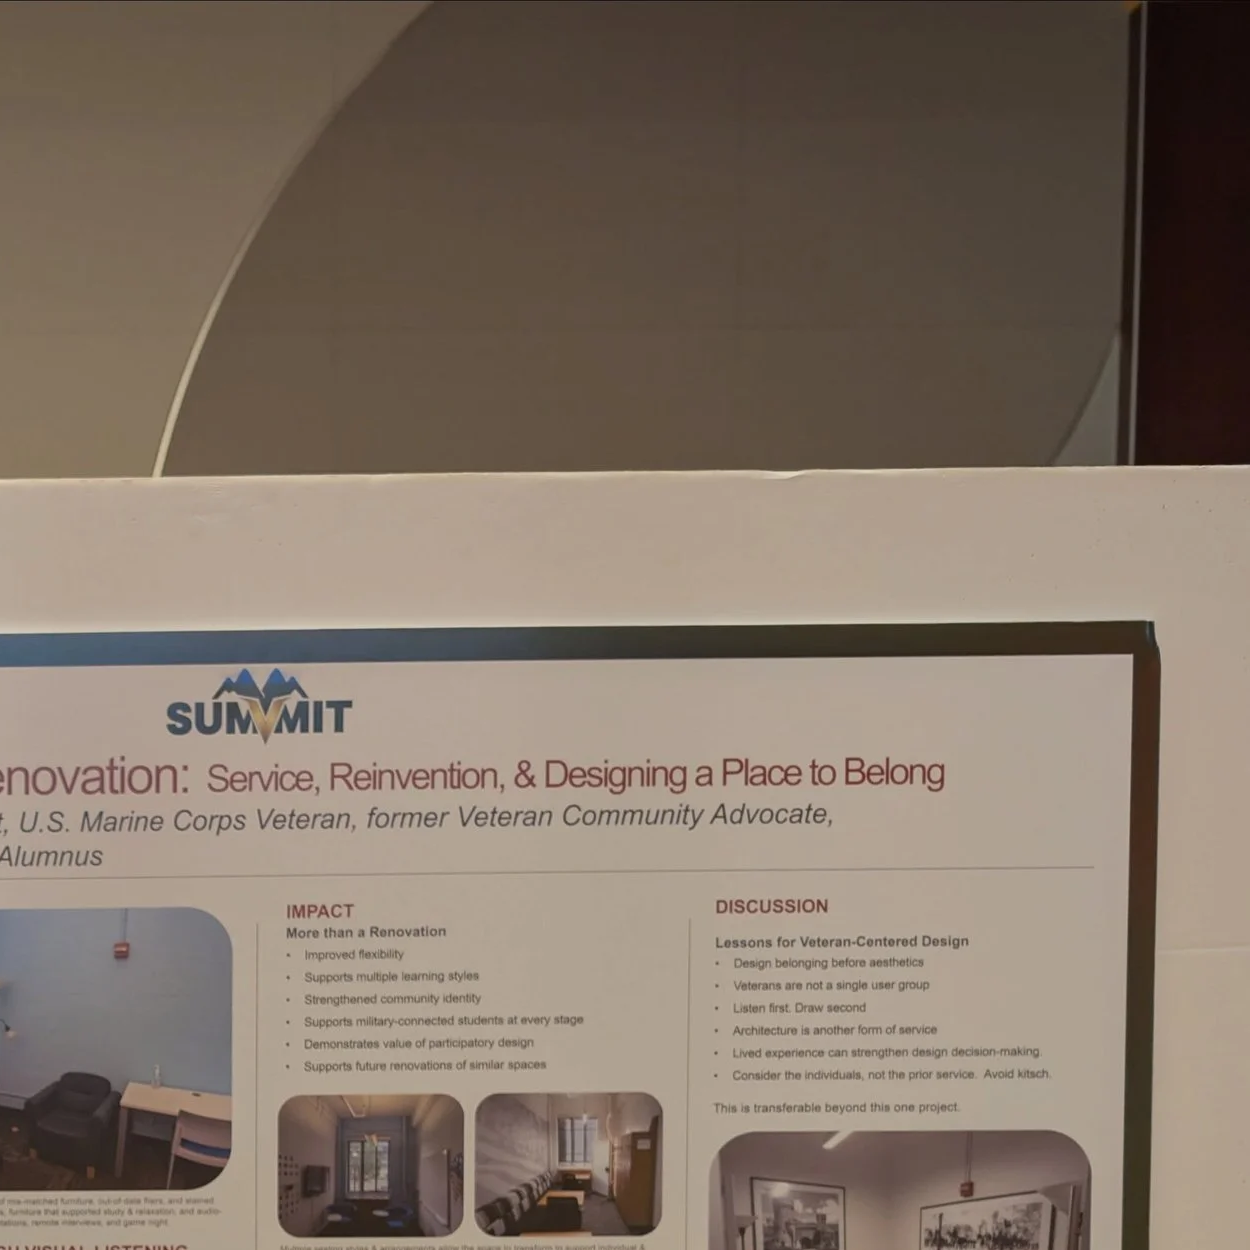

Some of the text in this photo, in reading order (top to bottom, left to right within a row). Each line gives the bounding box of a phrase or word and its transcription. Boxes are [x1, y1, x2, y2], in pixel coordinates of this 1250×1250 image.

[166, 699, 353, 740] SUMMIT
[207, 762, 320, 796] Service,
[329, 760, 505, 794] Reinvention,
[513, 759, 536, 788] &
[544, 758, 687, 795] Designing
[694, 765, 713, 787] a
[721, 757, 803, 786] Place
[809, 758, 837, 786] to
[844, 755, 945, 793] Belong
[19, 810, 69, 833] U.S.
[79, 809, 164, 832] Marine
[173, 808, 246, 836] Corps
[256, 807, 356, 832] Veteran,
[366, 805, 450, 828] former
[458, 804, 553, 827] Veteran
[562, 802, 705, 832] Community
[709, 801, 832, 828] Advocate,
[286, 903, 355, 918] IMPACT
[715, 898, 828, 914] DISCUSSION
[286, 925, 446, 938] More than a Renovation
[715, 934, 969, 949] Lessons for Veteran-Centered Design
[304, 948, 403, 962] Improved flexibility
[733, 956, 923, 970] Design belonging before aesthetics
[304, 970, 479, 984] Supports multiple learning styles
[733, 979, 929, 992] Veterans are not a single user group
[304, 992, 481, 1007] Strengthened community identity
[733, 1001, 866, 1013] Listen first. Draw second
[304, 1014, 583, 1029] Supports military-connected students at every stage
[732, 1023, 937, 1036] Architecture is another form of service
[304, 1037, 533, 1050] Demonstrates value of participatory design
[732, 1068, 1051, 1081] Consider the individuals, not the prior service. Avoid kitsch.
[713, 1102, 961, 1114] This is transferable beyond this one project.
